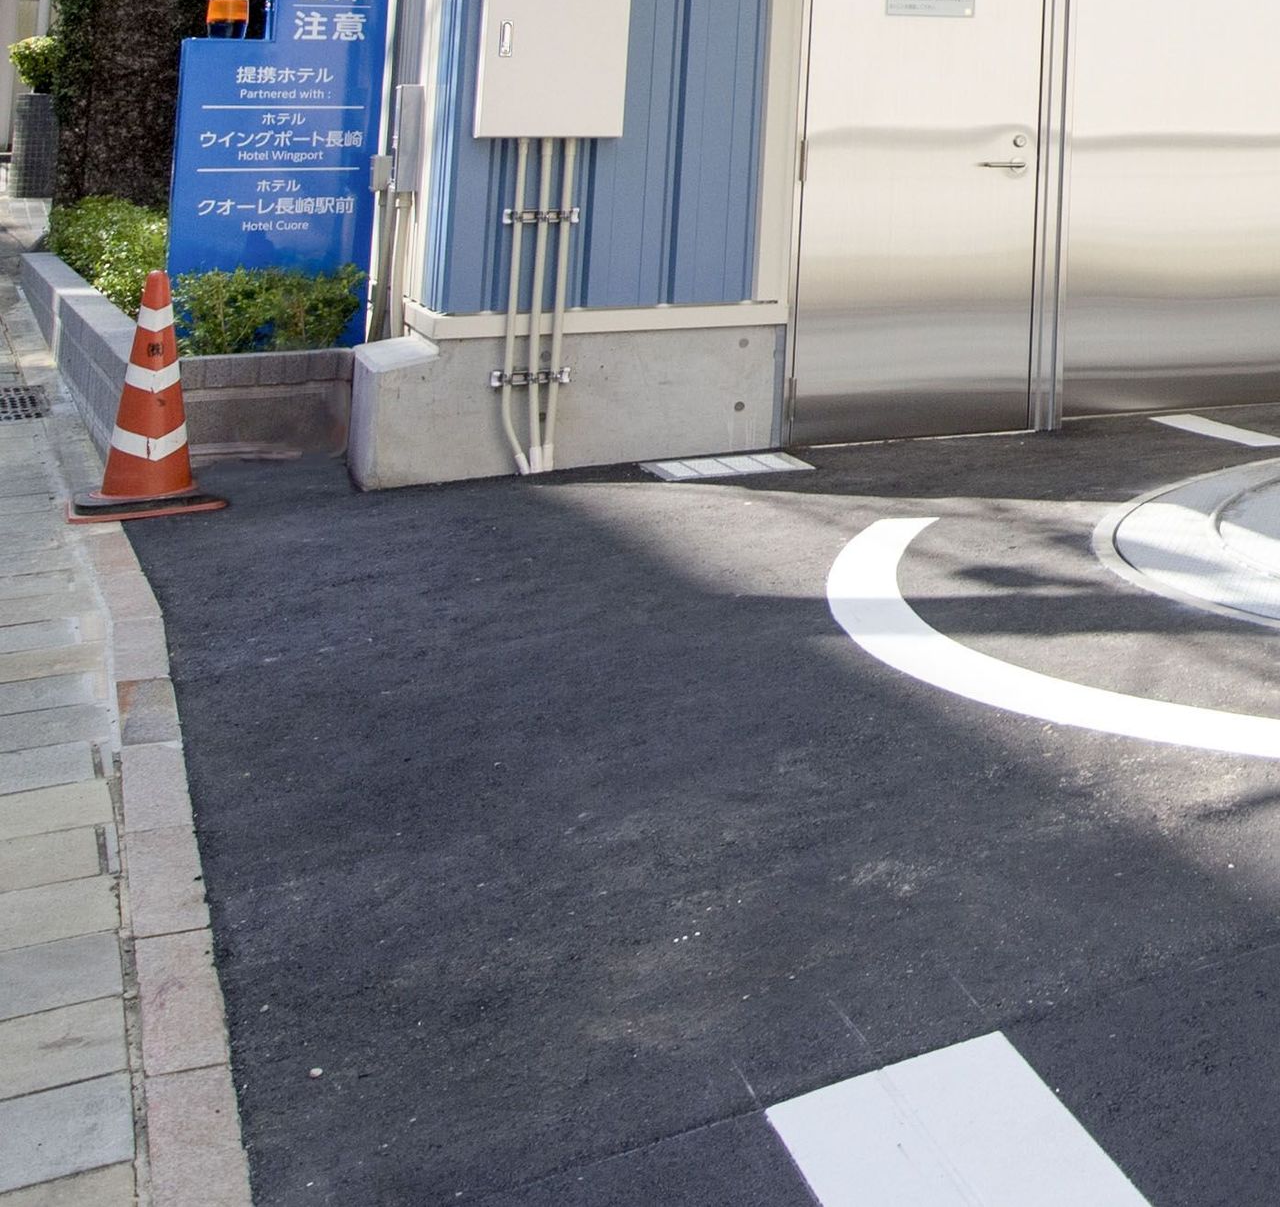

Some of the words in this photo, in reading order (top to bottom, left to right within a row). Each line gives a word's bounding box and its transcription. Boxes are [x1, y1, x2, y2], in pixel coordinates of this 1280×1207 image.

[293, 10, 367, 41] 注意
[235, 65, 334, 84] 提携ホテル
[239, 88, 297, 100] Partnered
[261, 112, 306, 126] ホテル
[200, 130, 364, 148] ウイングポート長崎
[238, 150, 269, 161] Hotel
[271, 150, 324, 163] Wingport
[256, 179, 302, 193] ホテル
[197, 196, 356, 217] クオーレ長崎駅前
[241, 221, 273, 232] Hotel
[275, 220, 310, 232] Cuore
